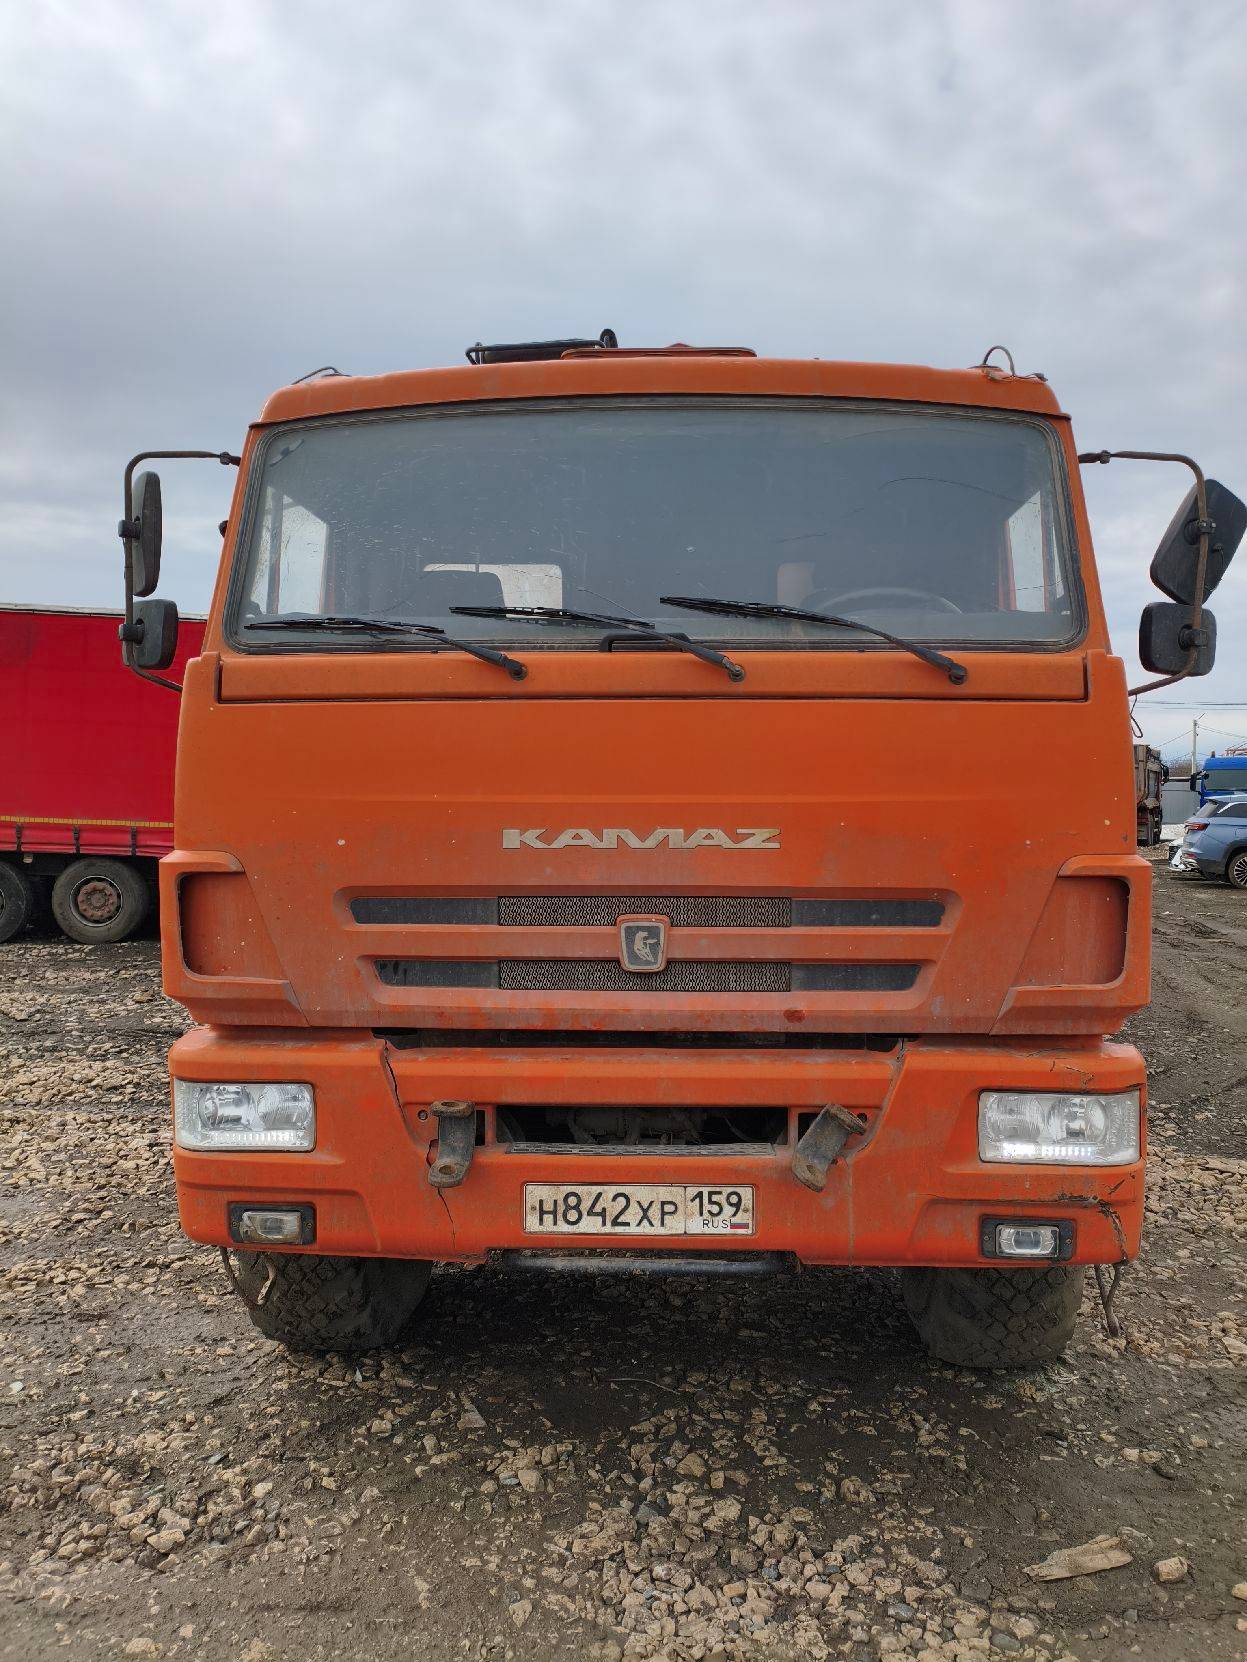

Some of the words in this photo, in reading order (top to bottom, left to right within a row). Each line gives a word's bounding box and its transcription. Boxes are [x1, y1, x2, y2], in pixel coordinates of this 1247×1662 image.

[502, 828, 781, 849] KAMAZ
[690, 1190, 743, 1218] 159
[702, 1218, 729, 1229] RUS
